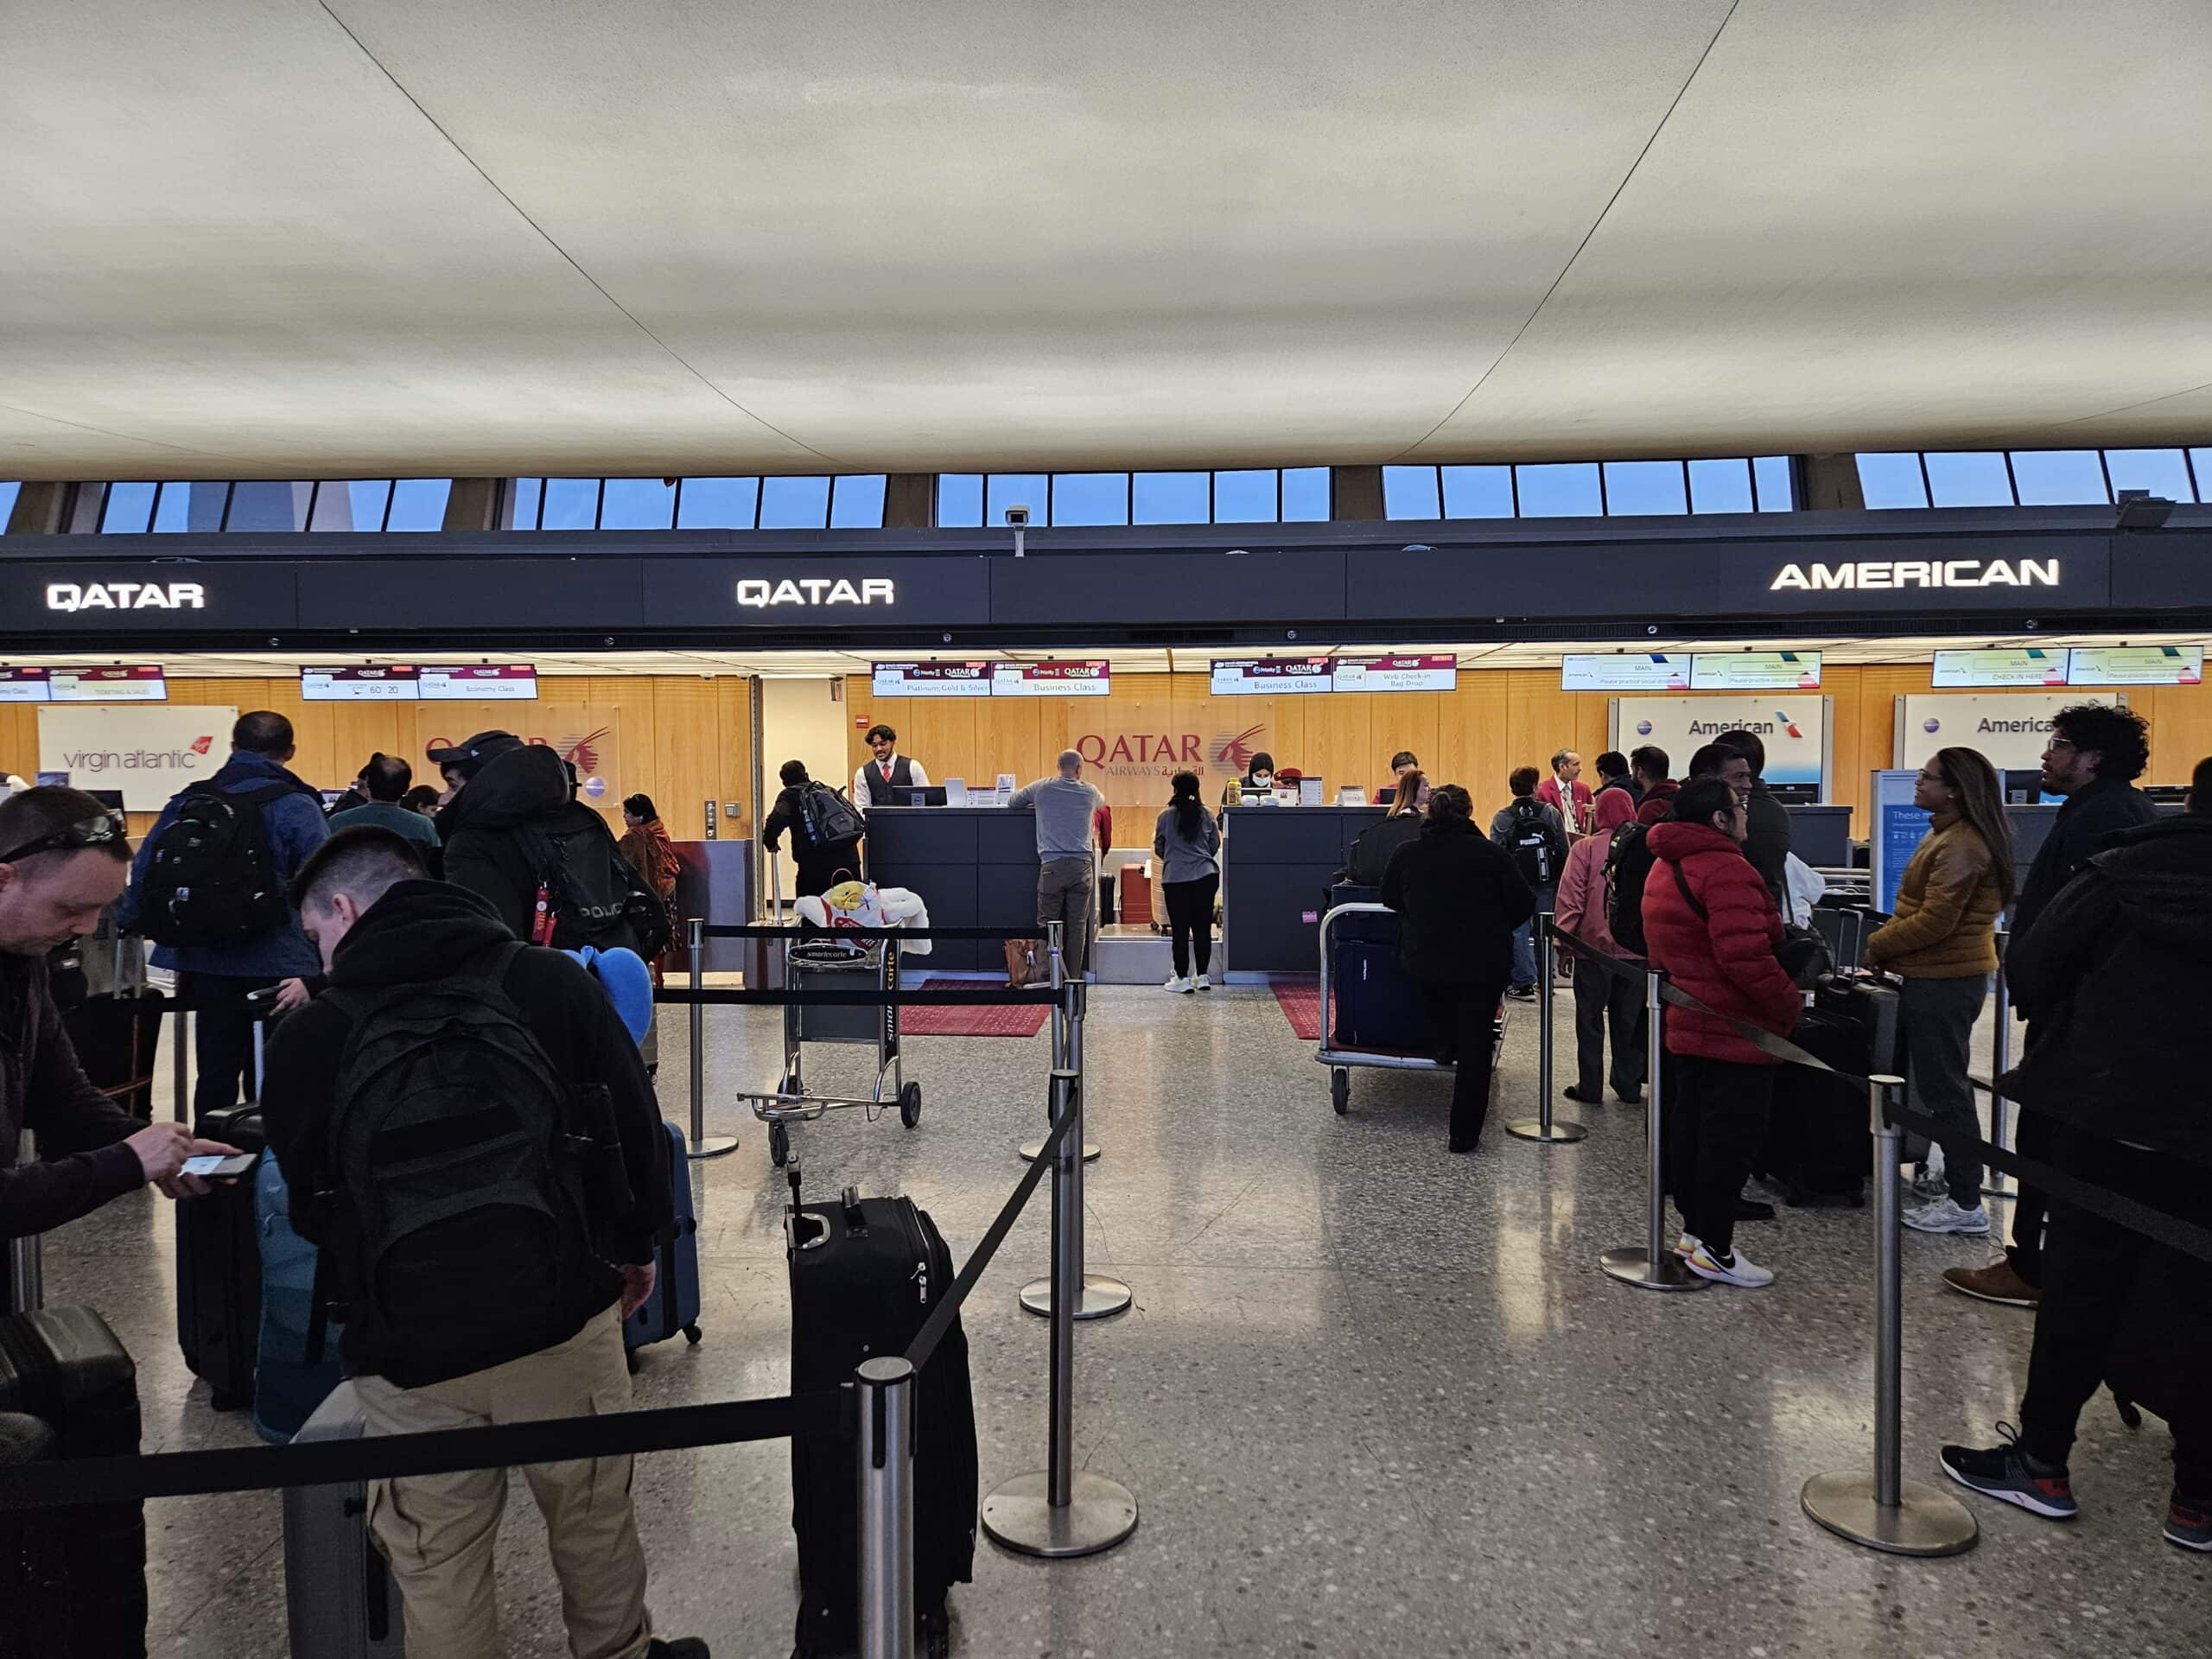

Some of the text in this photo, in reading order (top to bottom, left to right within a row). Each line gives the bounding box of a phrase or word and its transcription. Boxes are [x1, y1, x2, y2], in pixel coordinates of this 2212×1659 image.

[1770, 559, 2058, 590] AMERICAN
[46, 582, 205, 612] QATAR
[737, 578, 894, 607] QATAR
[944, 668, 970, 677] QATAR
[1064, 667, 1090, 676] QATAR
[1285, 664, 1313, 672] QATAR
[369, 685, 382, 695] 60
[387, 685, 399, 695] 20
[1033, 683, 1096, 692] Business Class
[1254, 680, 1318, 690] Business Class
[1977, 716, 2054, 733] America
[1076, 734, 1204, 770] QATAR
[63, 749, 195, 772] virgin atlantic
[1106, 766, 1161, 777] AIRWAYS
[1892, 810, 1921, 820] These
[580, 902, 623, 918] POLIC
